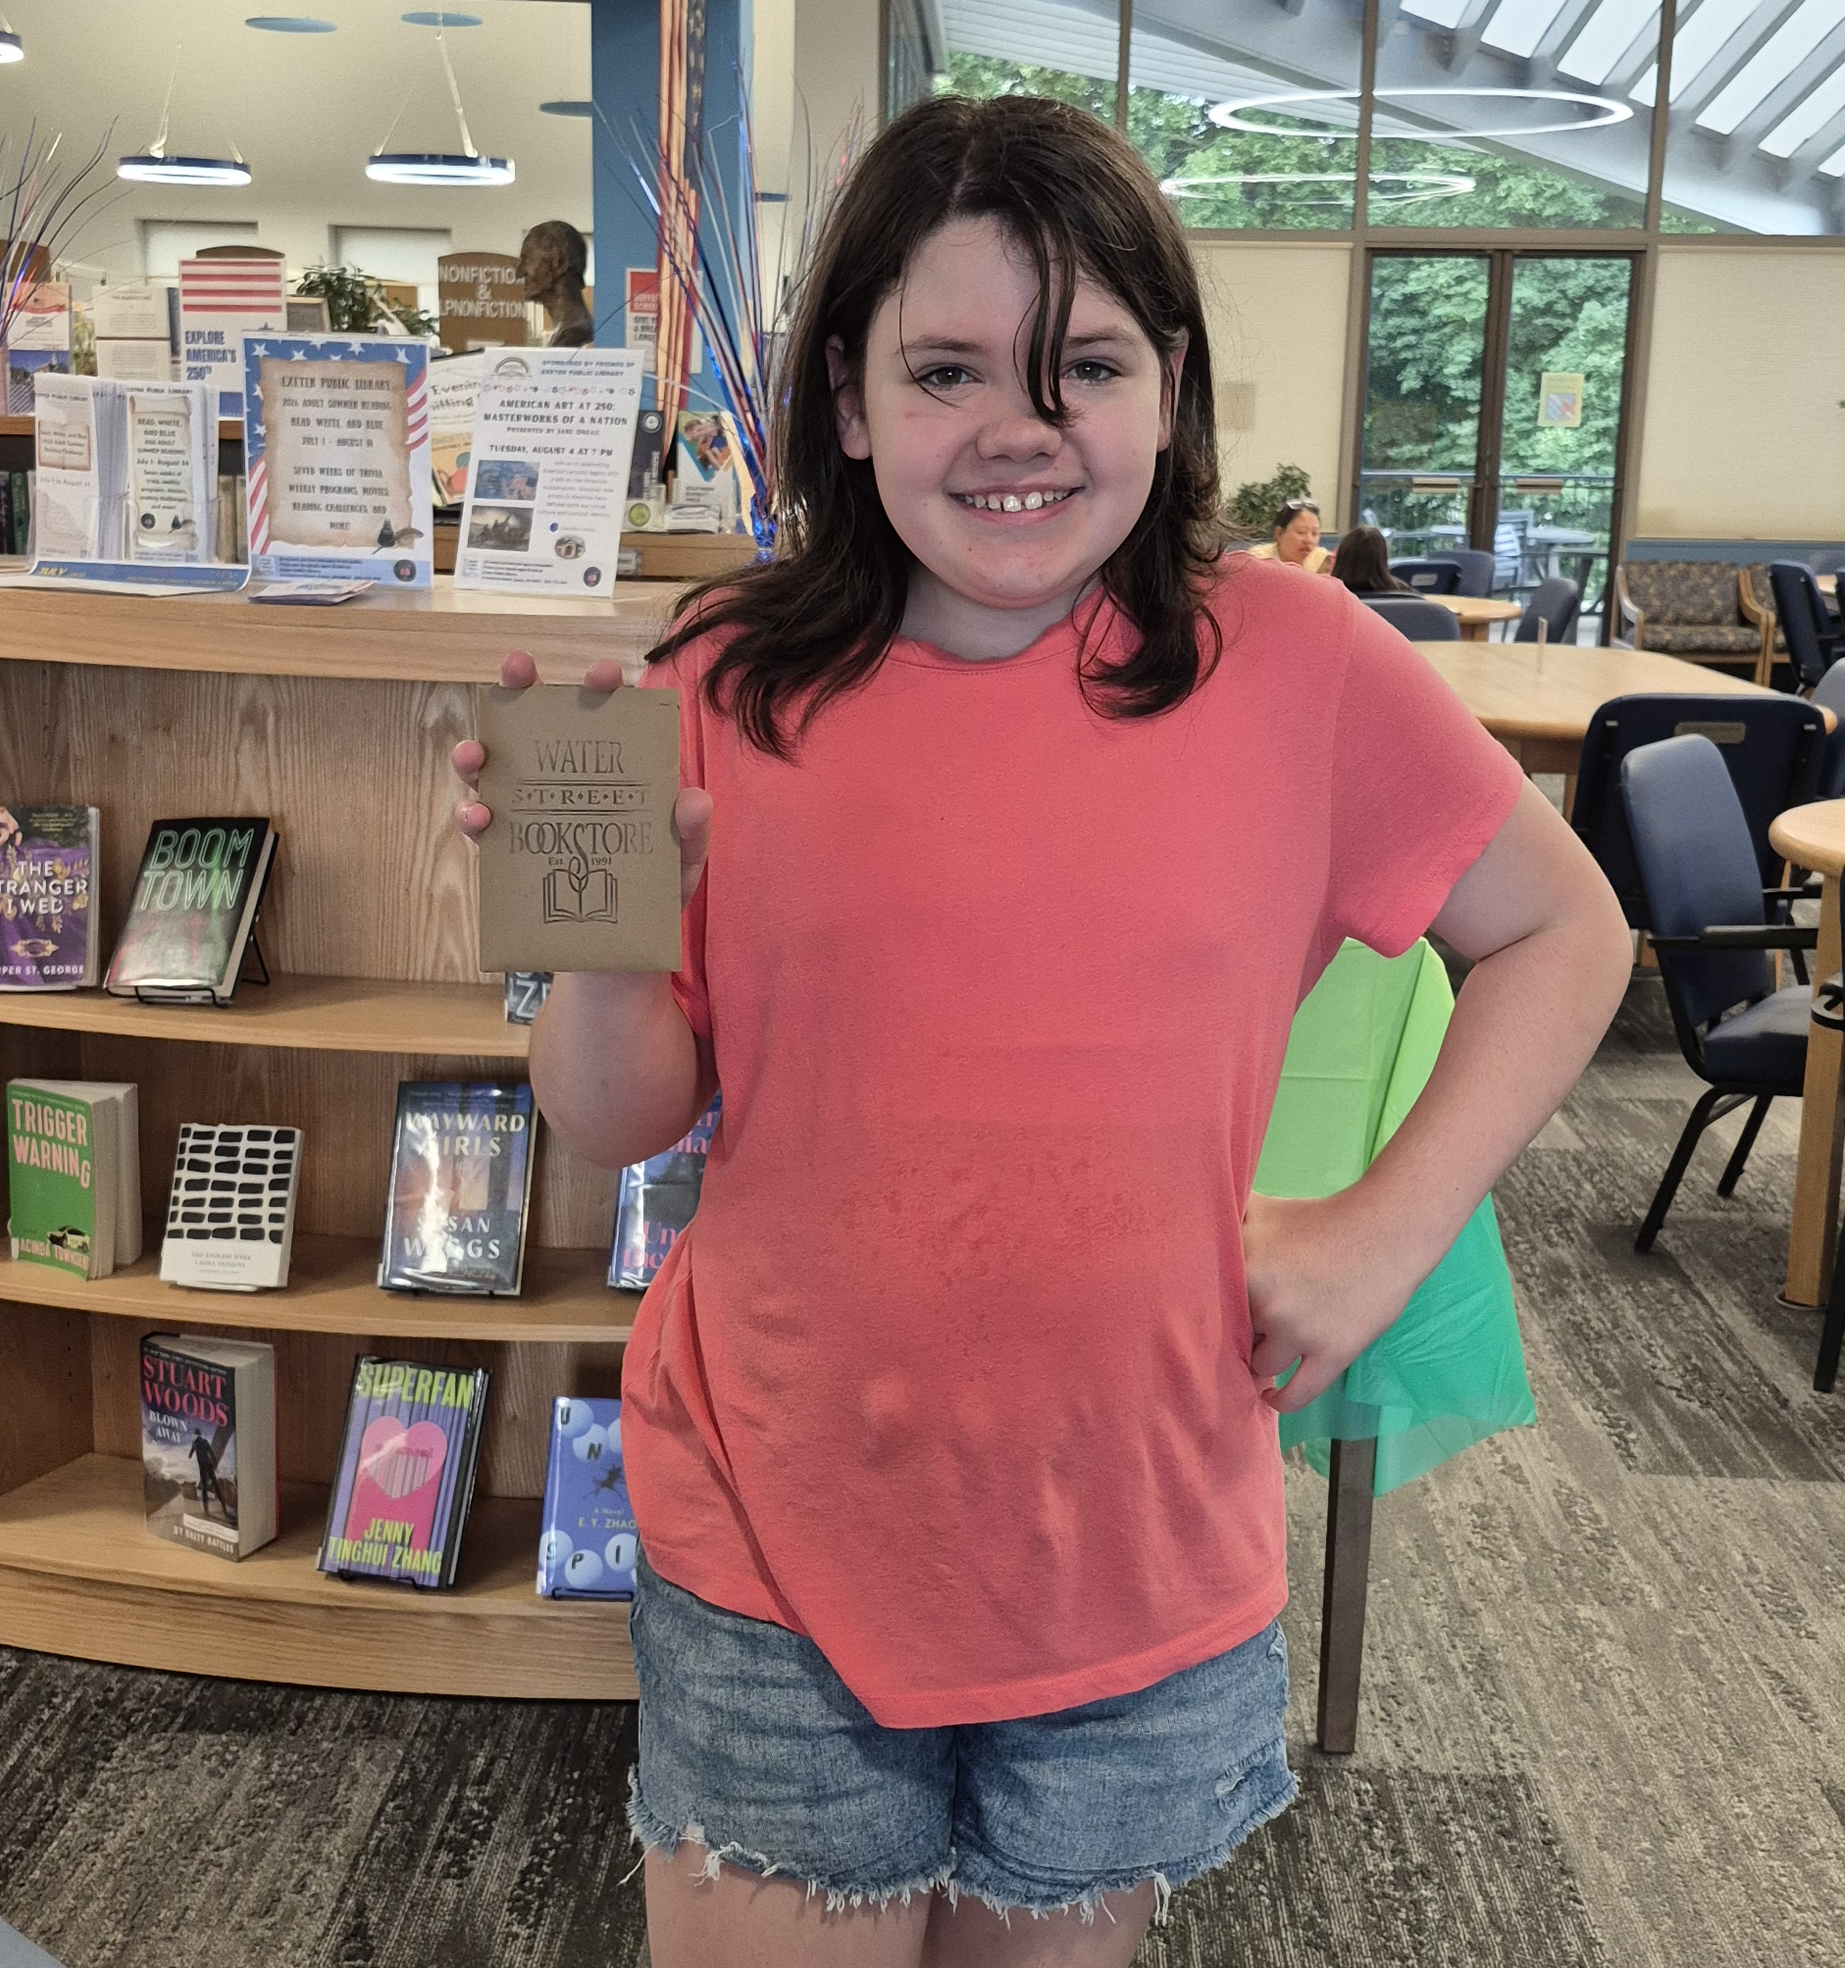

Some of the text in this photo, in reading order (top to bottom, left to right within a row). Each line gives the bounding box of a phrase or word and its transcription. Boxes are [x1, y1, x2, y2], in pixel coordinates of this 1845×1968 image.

[440, 264, 525, 284] NONFICTIO
[477, 284, 492, 300] &
[440, 300, 527, 318] LPNONFICTION
[185, 330, 225, 345] EXPLORE
[186, 349, 236, 363] AMERICA'S
[282, 376, 390, 391] EXETER PUBLIC LIBRARY
[430, 380, 481, 395] Evenin
[500, 400, 550, 410] AMERICAN
[554, 401, 574, 410] ART
[578, 402, 591, 411] AT
[347, 419, 362, 430] AND
[484, 413, 559, 424] MASTERWORKS
[563, 415, 575, 424] OF
[579, 416, 586, 424] A
[590, 416, 628, 426] NATION
[302, 437, 319, 446] JULY
[337, 438, 363, 447] AUGUST
[490, 444, 529, 455] TUESDAY,
[532, 446, 565, 455] AUGUST
[346, 468, 355, 477] OF
[534, 740, 625, 774] WATER
[509, 821, 653, 857] BOOKSTORE
[150, 828, 255, 870] BOOM
[18, 861, 53, 876] THE
[591, 857, 612, 866] 1991
[140, 869, 244, 911] TOWN
[7, 898, 64, 915] I WED
[0, 965, 84, 976] PER ST. GEORGE
[11, 1098, 87, 1147] TRIGGER
[442, 1136, 501, 1157] IRLS
[12, 1134, 91, 1188] WARNING
[418, 1216, 490, 1233] SAN
[20, 1237, 51, 1257] ACINDA
[143, 1354, 226, 1400] STUART
[357, 1362, 474, 1409] SUPERFAN
[144, 1380, 229, 1427] WOODS
[149, 1410, 187, 1432] BLOWN
[156, 1427, 181, 1443] AWAY
[560, 1406, 602, 1460] U N
[173, 1525, 183, 1537] BY
[363, 1517, 414, 1546] JENNY
[605, 1519, 637, 1530] ZHAO
[328, 1536, 442, 1577] TINGHUI ZHANG
[571, 1553, 584, 1569] P
